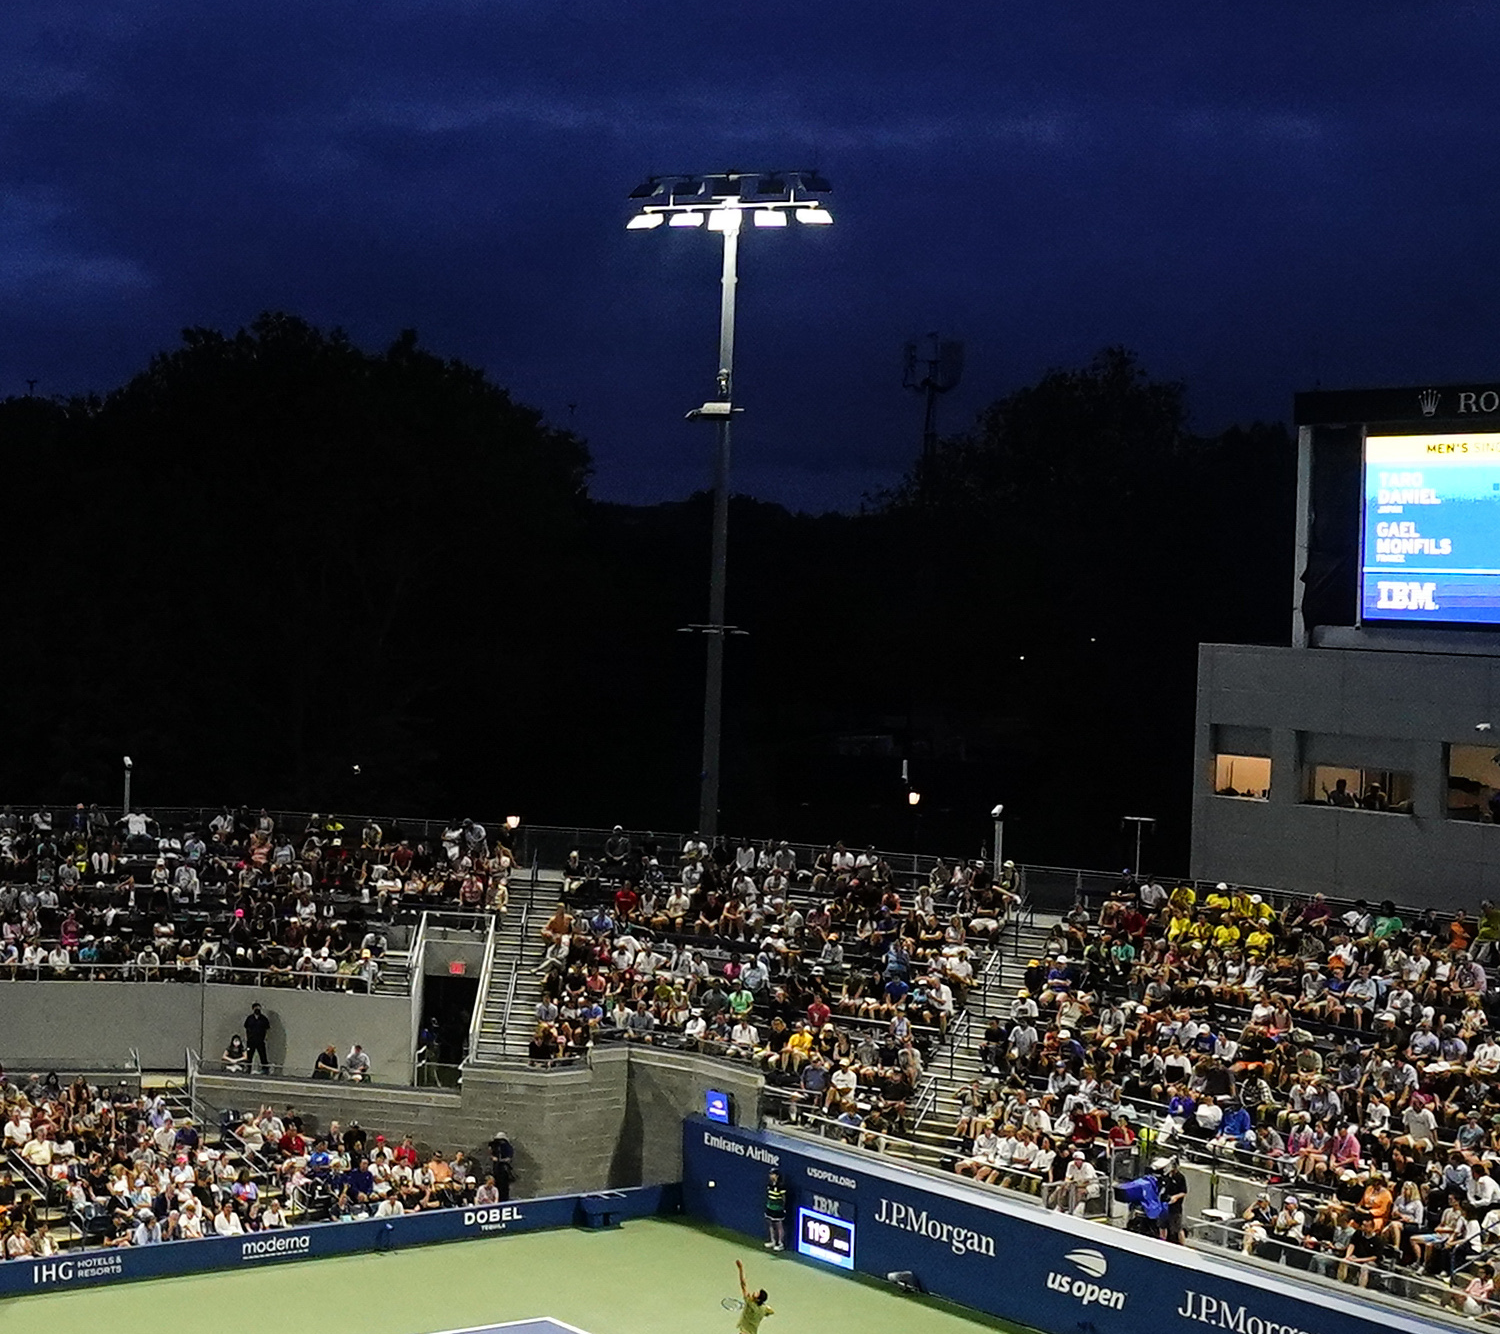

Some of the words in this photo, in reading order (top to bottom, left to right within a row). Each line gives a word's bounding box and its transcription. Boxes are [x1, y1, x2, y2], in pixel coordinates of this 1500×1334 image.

[1427, 442, 1468, 454] MEN'S
[1378, 488, 1441, 505] DANIEL
[1377, 521, 1420, 538] GAEL
[1376, 538, 1452, 555] MONFILS
[1377, 581, 1437, 610] IBM
[704, 1133, 744, 1156] Emirates
[746, 1142, 780, 1166] Airline
[806, 1167, 857, 1189] USOPEN.ORG
[812, 1194, 840, 1217] IBM
[464, 1207, 522, 1225] DOBEL
[807, 1220, 831, 1244] 119
[874, 1198, 997, 1257] J.P.Morgan
[242, 1236, 310, 1255] moderna
[77, 1256, 114, 1268] HOTELS
[77, 1265, 122, 1278] RESORTS
[33, 1261, 73, 1284] IHG
[1069, 1281, 1126, 1311] open
